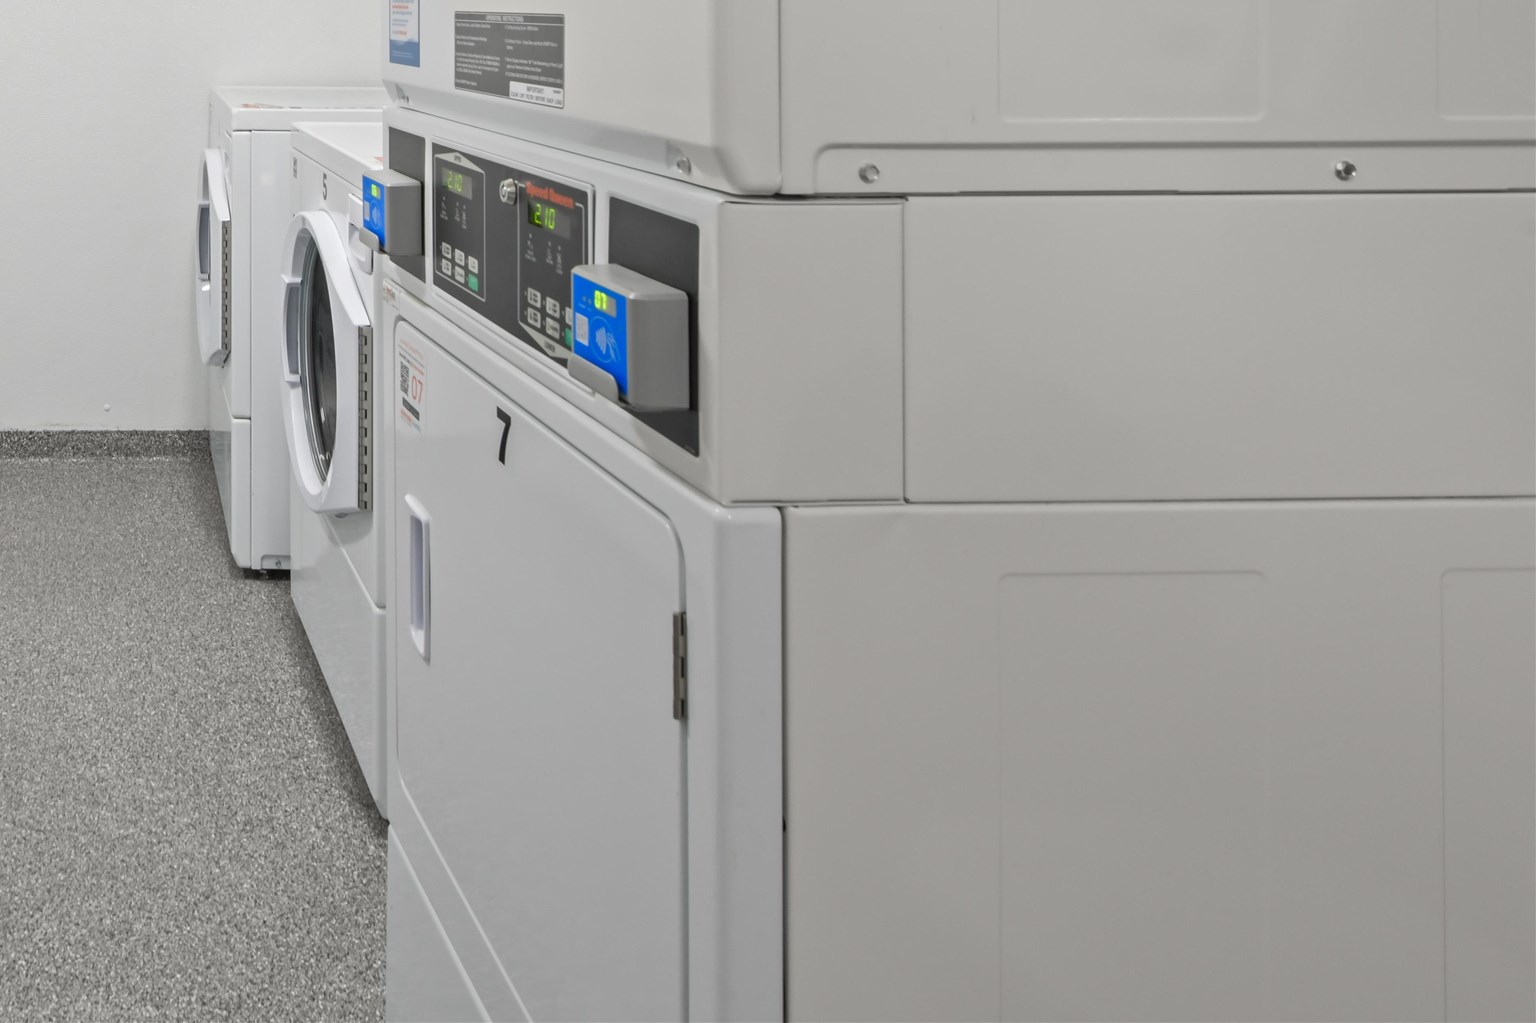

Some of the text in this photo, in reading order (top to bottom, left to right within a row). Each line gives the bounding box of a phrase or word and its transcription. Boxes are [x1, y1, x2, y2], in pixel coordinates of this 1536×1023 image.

[322, 172, 328, 200] 5
[525, 181, 574, 209] Speed Queen
[533, 203, 556, 230] 2.10
[594, 289, 607, 310] 07
[411, 376, 424, 404] 07
[496, 406, 511, 466] 7
